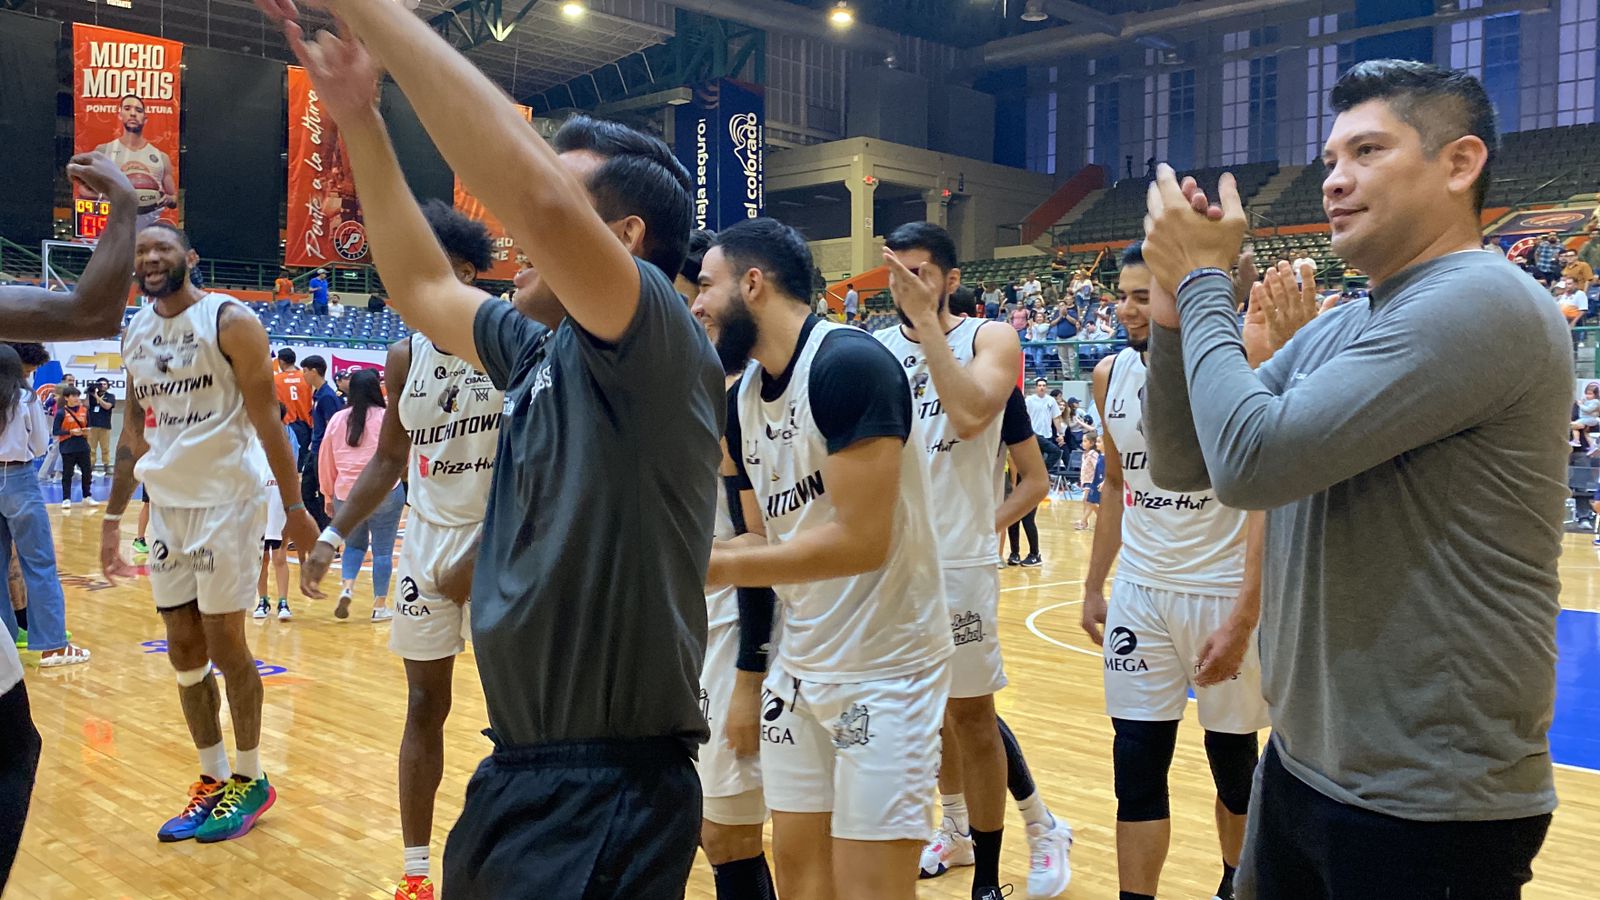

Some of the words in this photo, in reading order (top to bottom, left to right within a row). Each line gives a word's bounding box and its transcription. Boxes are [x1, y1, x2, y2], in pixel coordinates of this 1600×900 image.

[89, 41, 164, 70] MUCHO
[81, 68, 174, 100] MOCHIS
[86, 104, 118, 114] PONTE
[302, 89, 324, 145] altura
[304, 151, 323, 172] la
[743, 112, 758, 200] colorado
[312, 178, 322, 190] a
[743, 202, 758, 219] el
[304, 197, 326, 260] Ponte
[289, 385, 298, 400] 6
[931, 438, 960, 454] Hut
[432, 460, 473, 476] Pizza
[474, 457, 495, 473] Hu
[1133, 490, 1173, 509] Pizza
[1175, 494, 1214, 510] Hut
